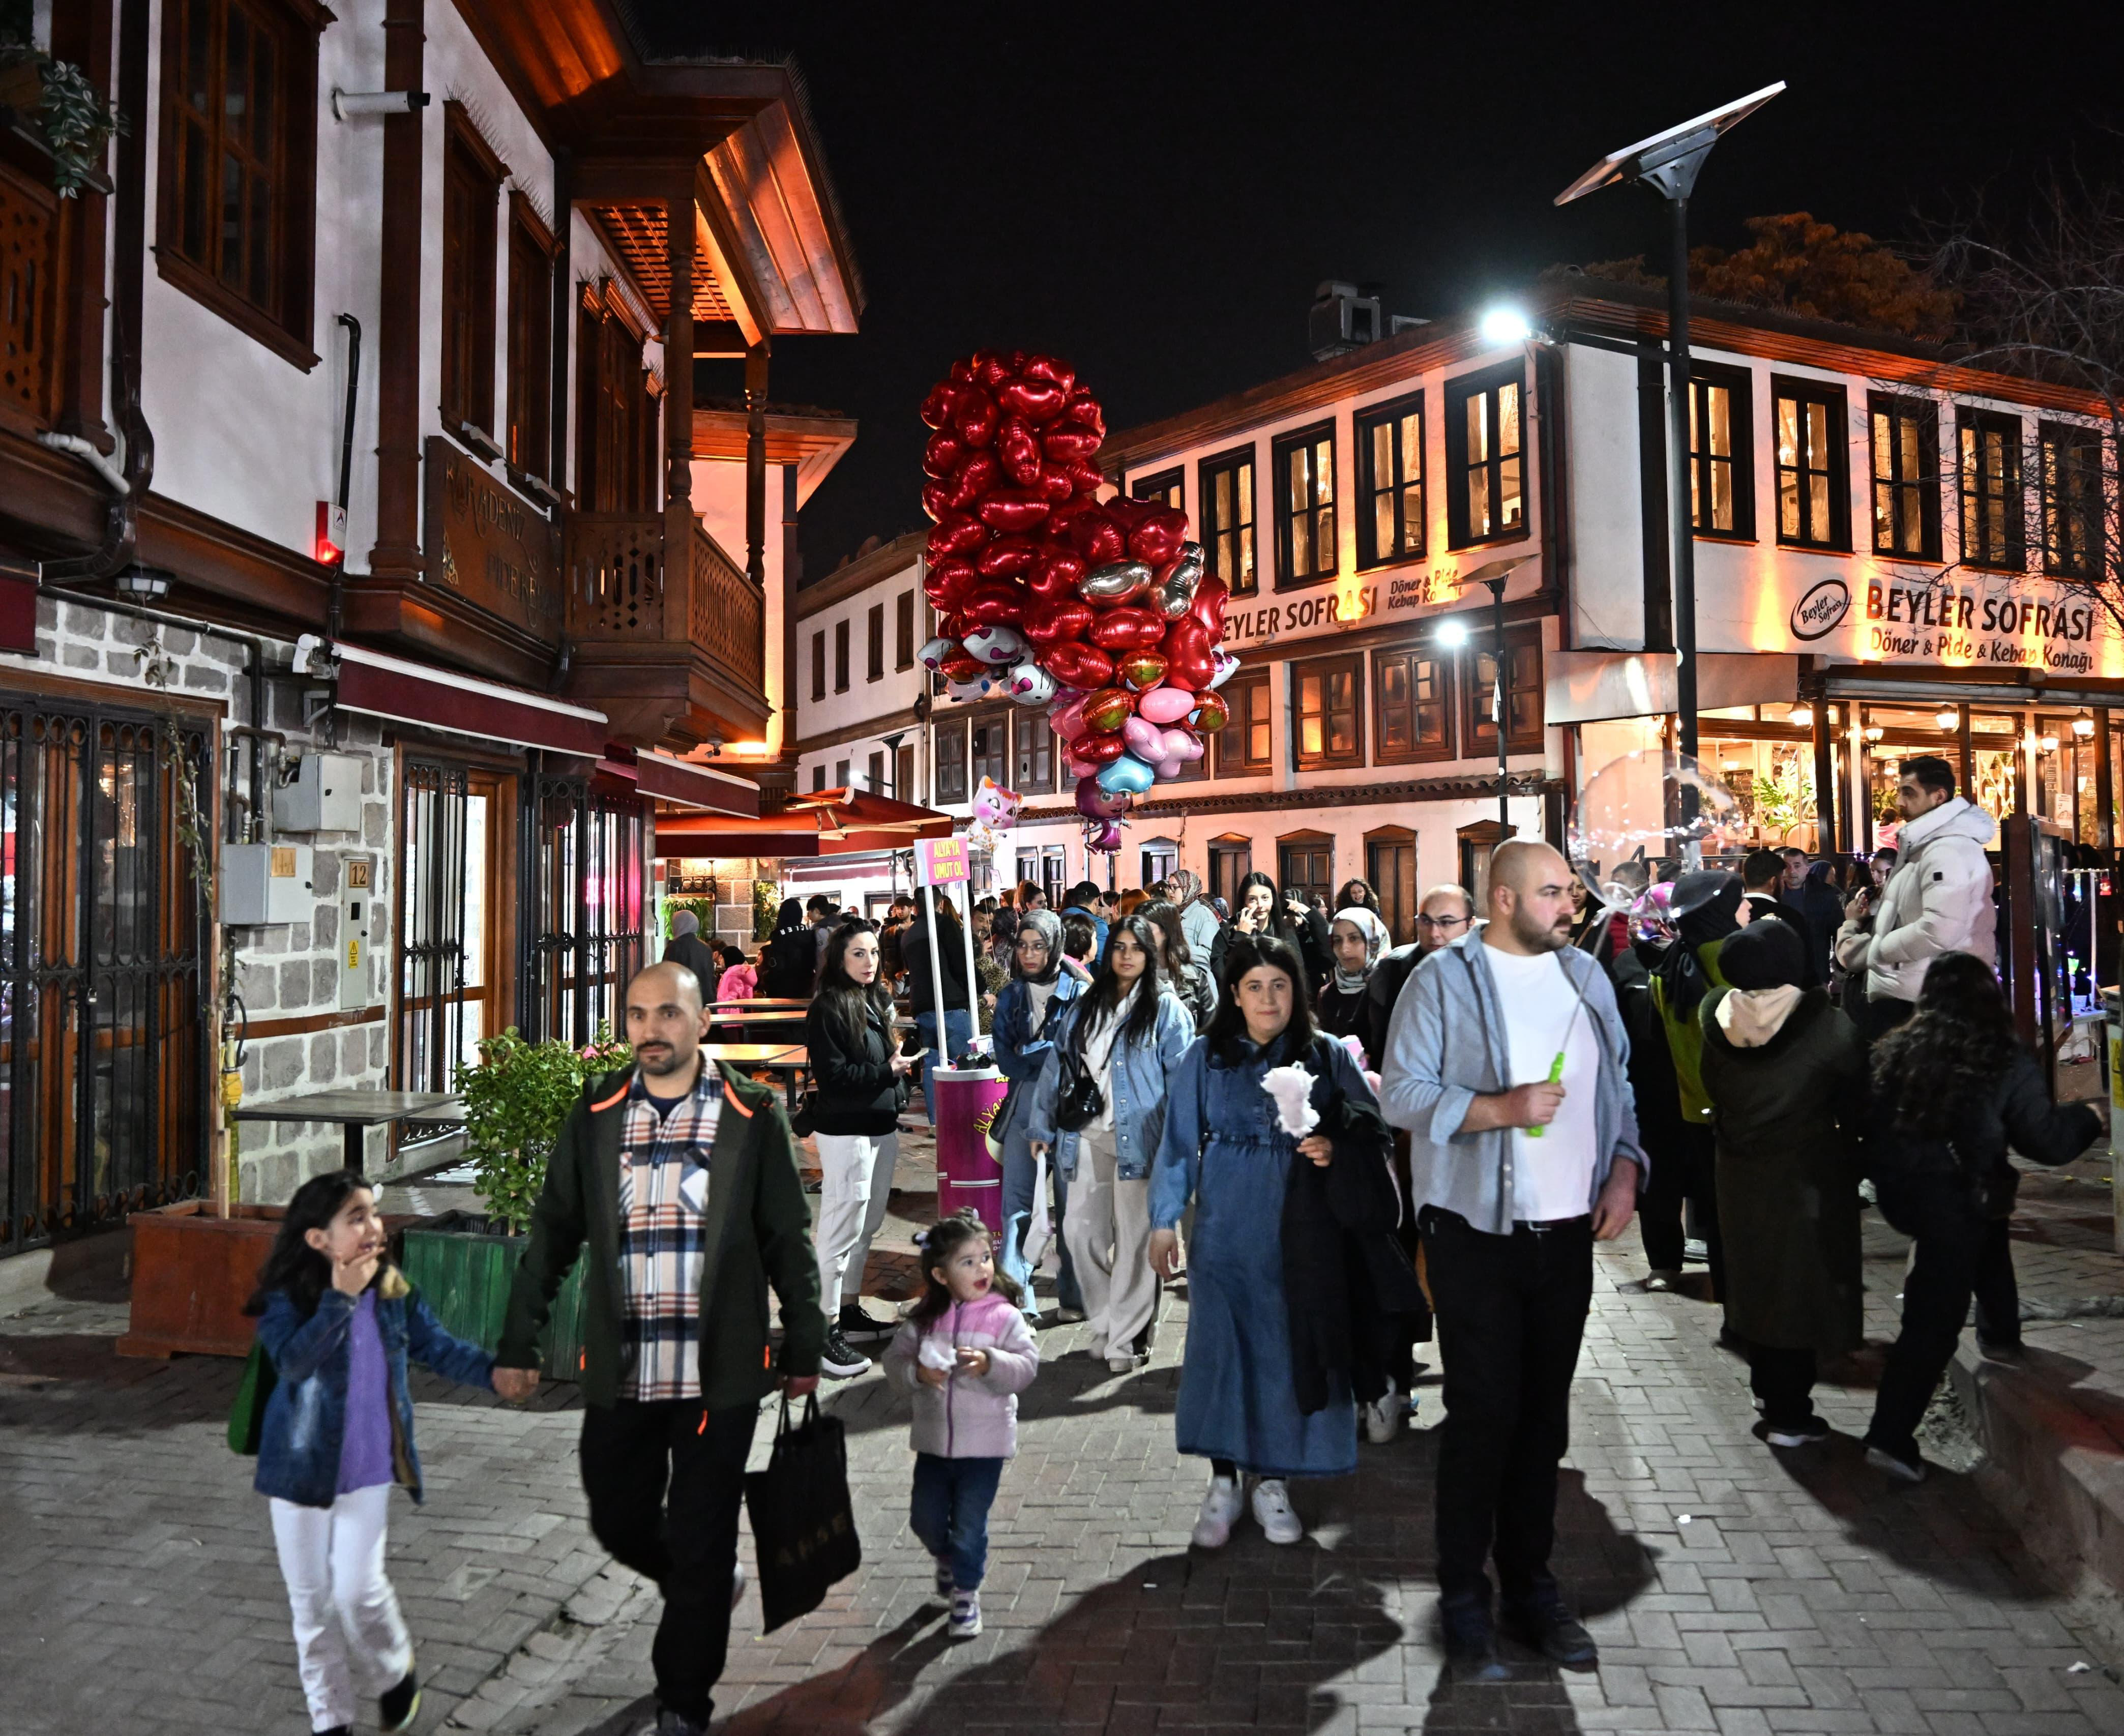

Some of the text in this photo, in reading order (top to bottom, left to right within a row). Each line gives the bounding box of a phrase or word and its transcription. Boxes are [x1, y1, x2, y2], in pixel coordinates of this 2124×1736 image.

[1391, 578, 1422, 595] Döner
[1388, 594, 1420, 609] Kebap
[1801, 595, 1827, 625] Beyler
[1818, 600, 1842, 624] Sofrası
[1222, 586, 1377, 642] EYLER SOFRASI
[1866, 585, 2093, 641] BEYLER SOFRASI
[1871, 629, 2093, 674] Döner & Pide & Kebap Konağı
[934, 840, 960, 859] ALYA'YA
[352, 865, 366, 885] 12
[934, 860, 964, 880] UMUT OL
